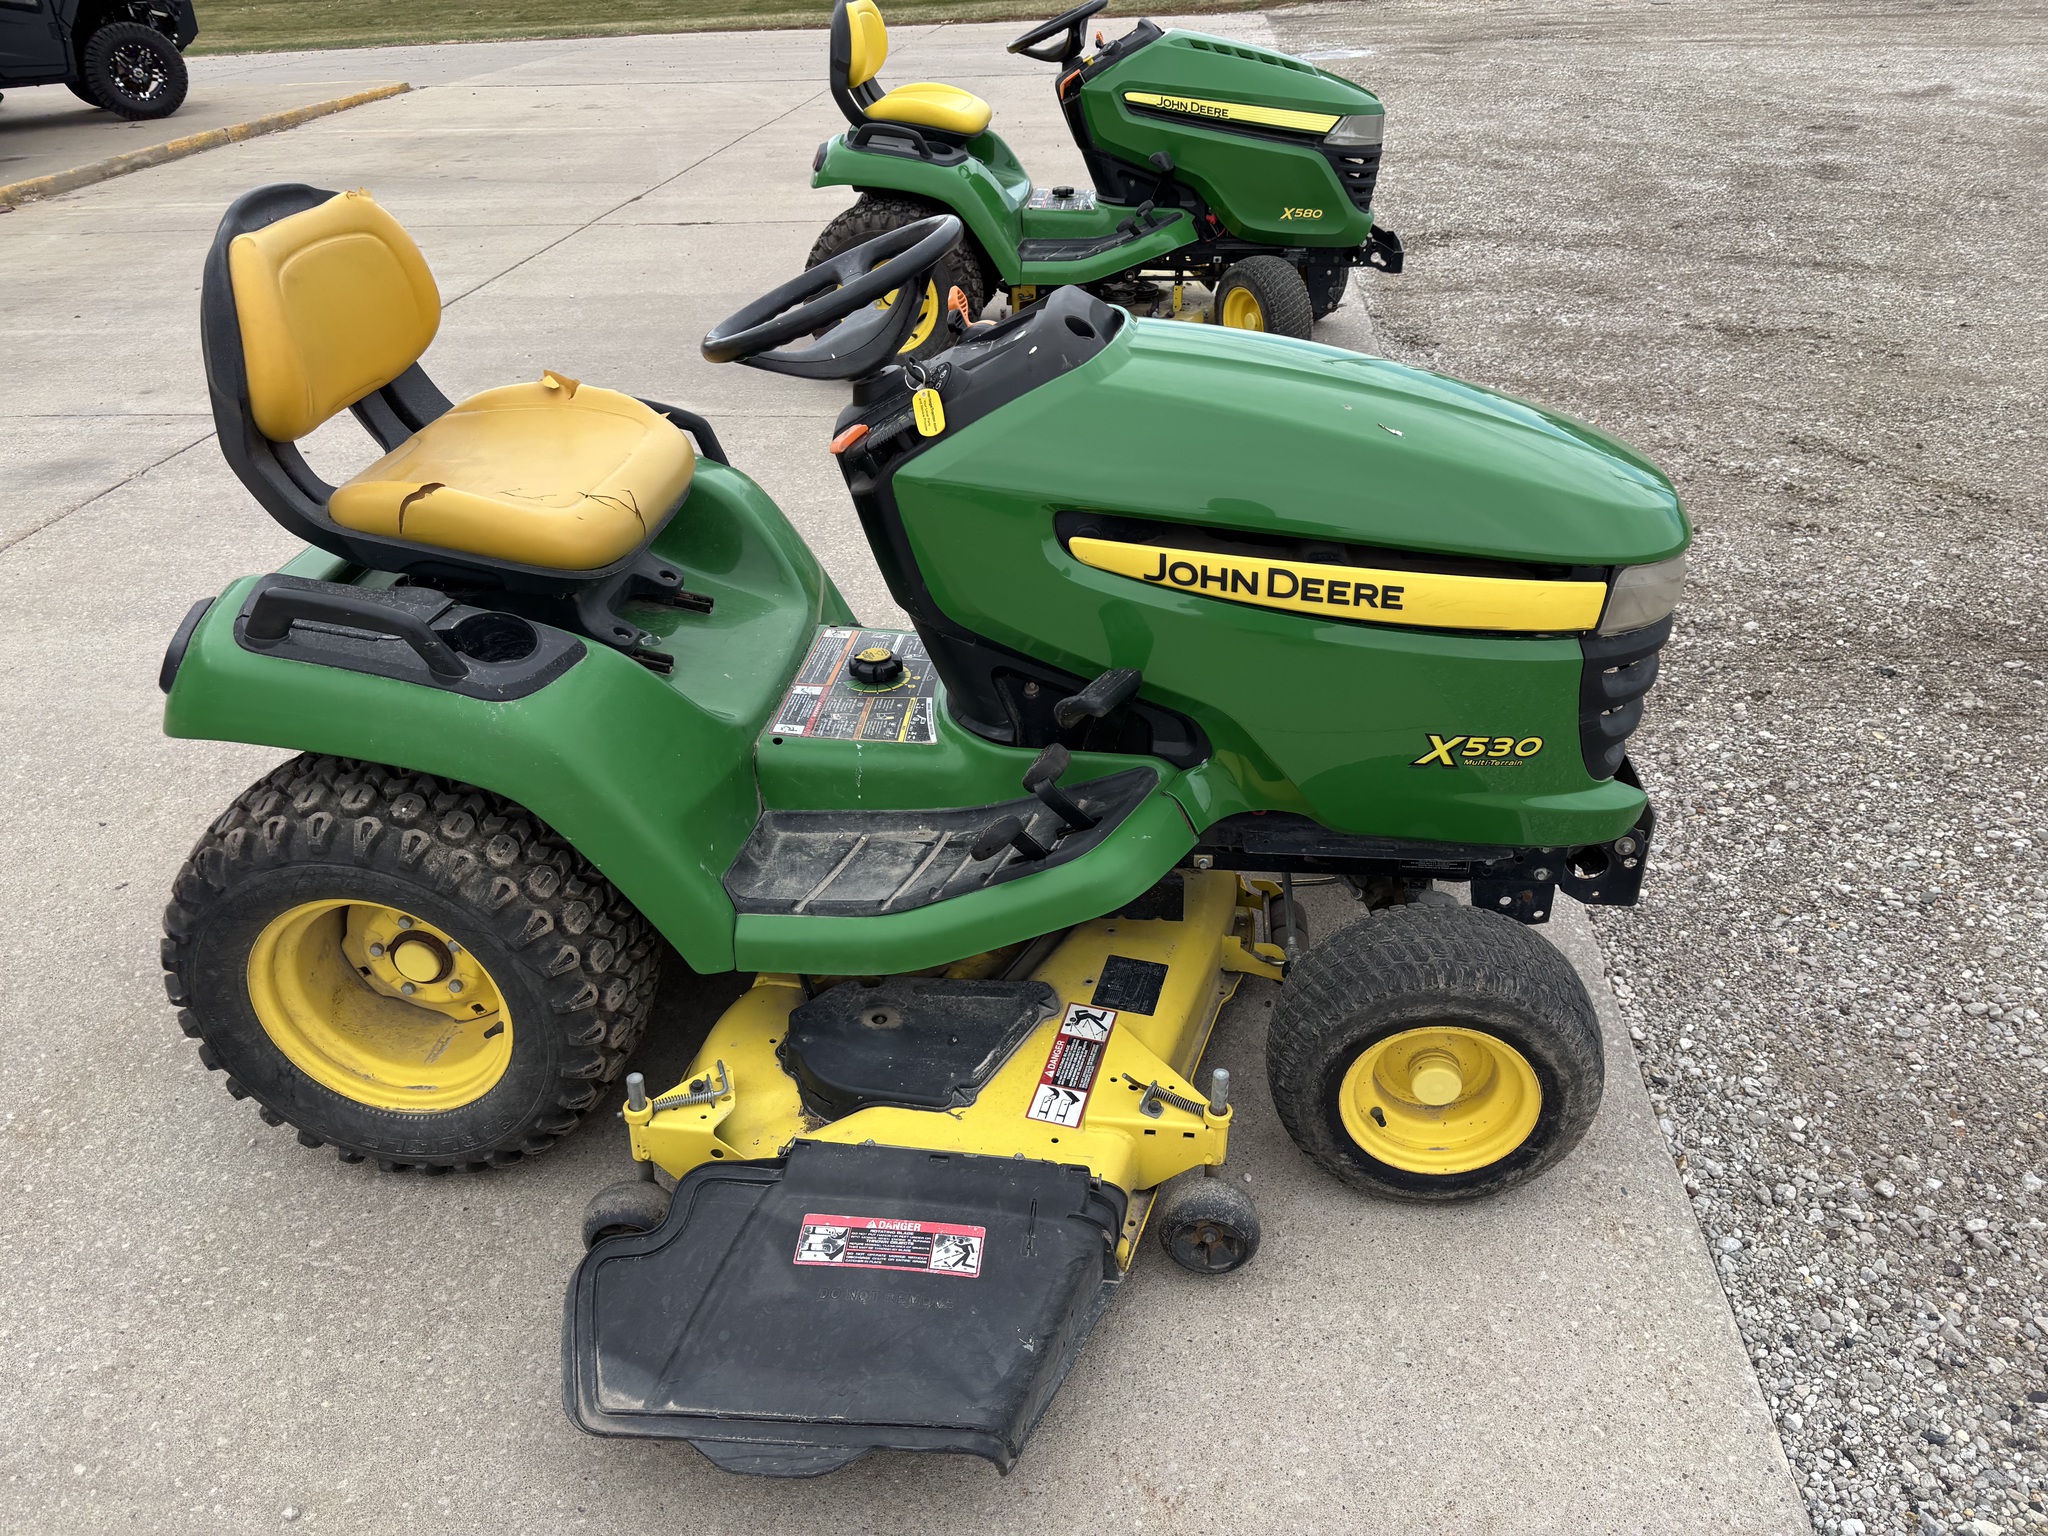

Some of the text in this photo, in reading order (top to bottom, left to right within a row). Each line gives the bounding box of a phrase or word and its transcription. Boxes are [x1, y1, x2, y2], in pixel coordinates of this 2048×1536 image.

[1156, 96, 1229, 118] JOHN DEERE
[1279, 207, 1323, 220] X580
[1143, 553, 1404, 611] JOHN DEERE
[1408, 733, 1544, 768] X530
[1047, 1040, 1065, 1070] DANGER
[878, 1221, 921, 1231] DANGER
